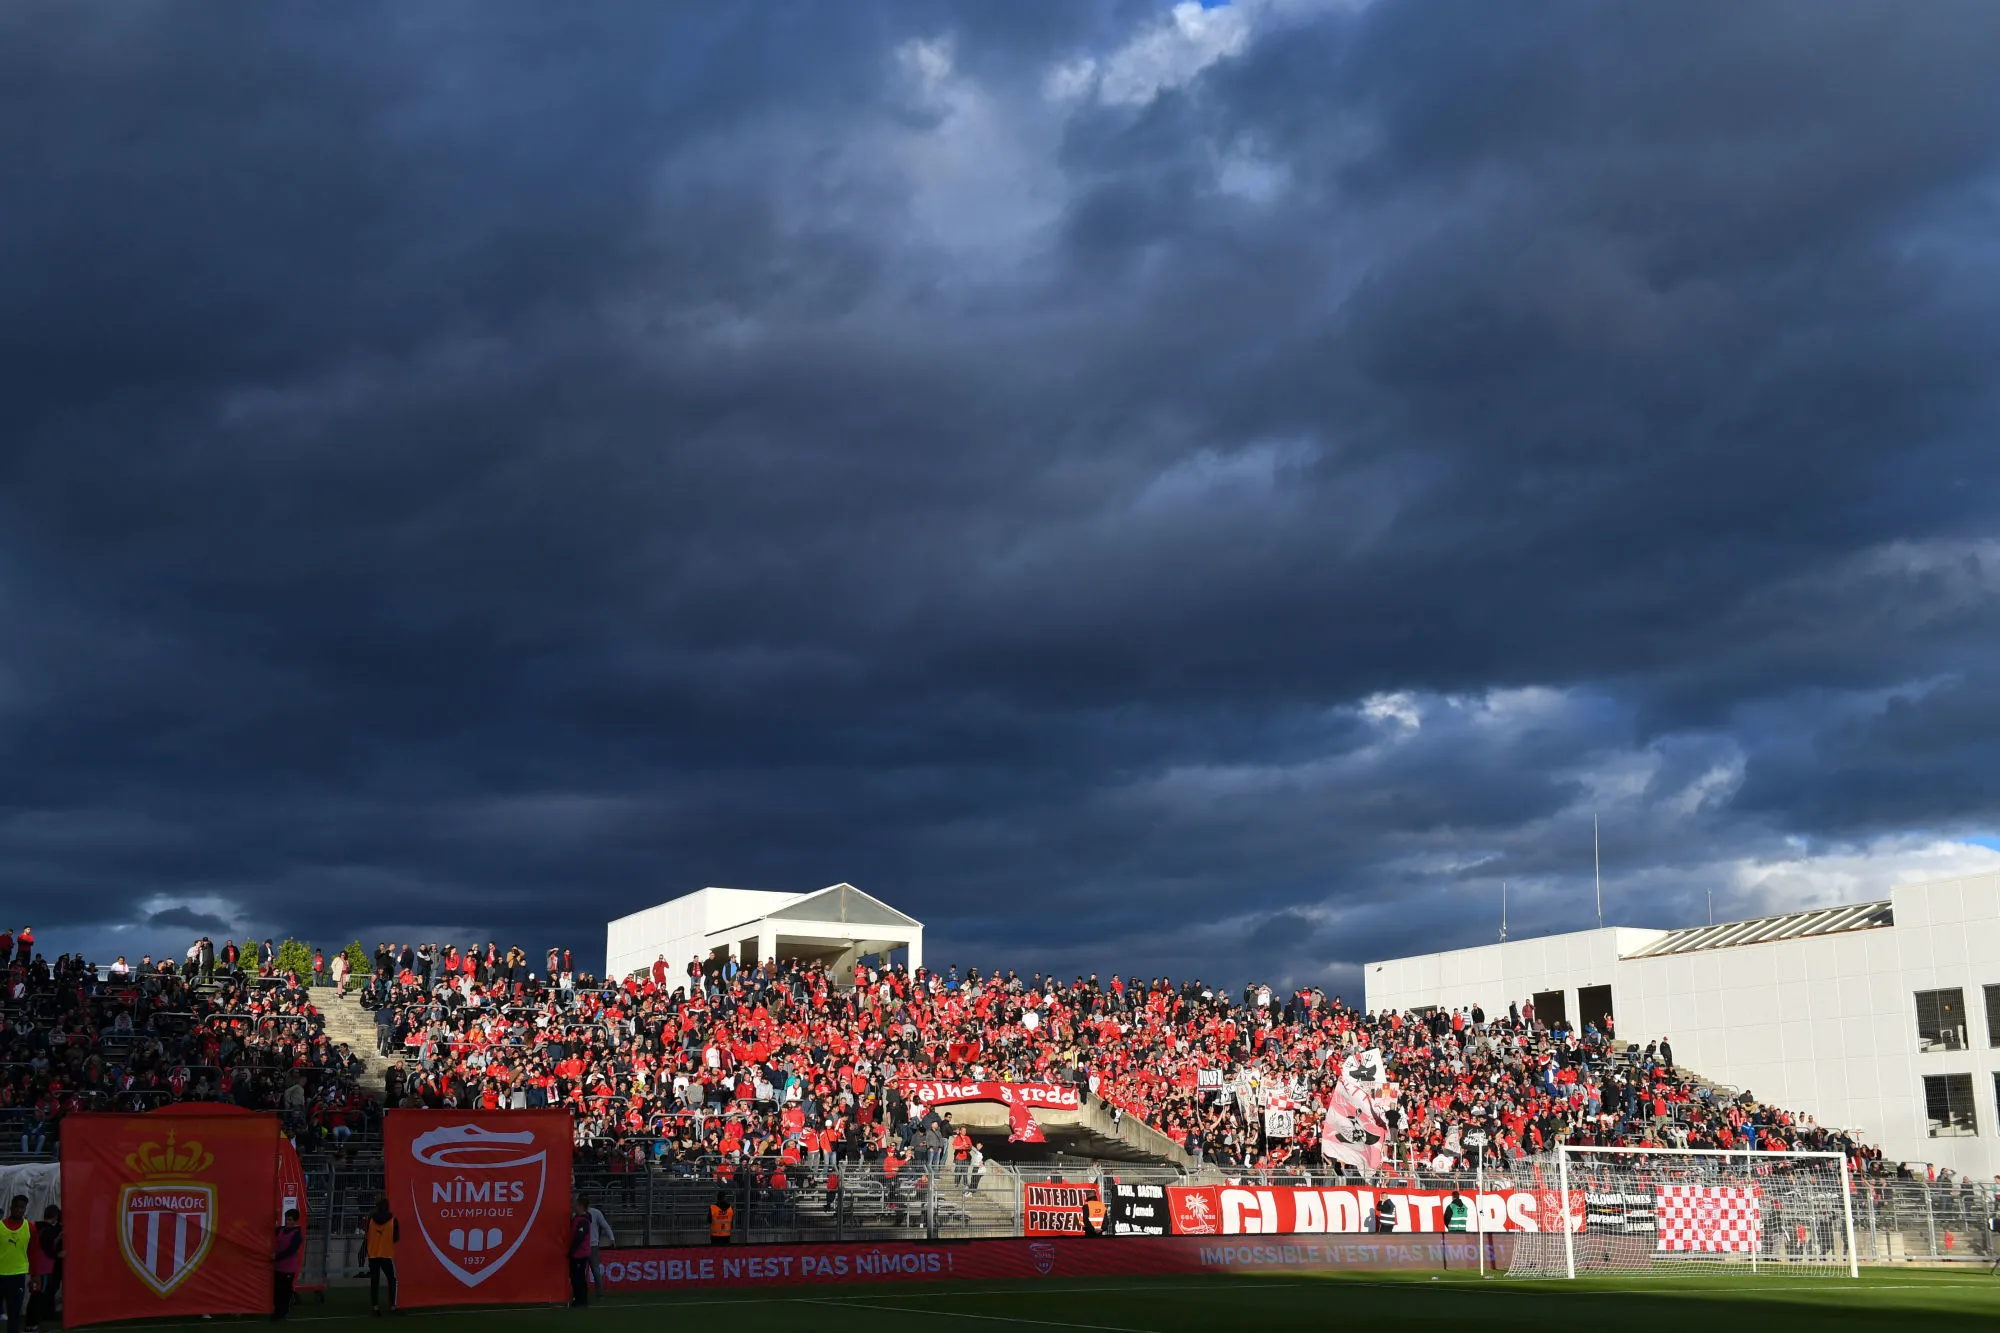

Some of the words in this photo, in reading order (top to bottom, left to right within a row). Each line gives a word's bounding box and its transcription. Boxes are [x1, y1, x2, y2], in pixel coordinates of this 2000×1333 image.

[432, 1175, 525, 1203] NÎMES
[440, 1208, 514, 1218] OLYMPIQUE
[1220, 1188, 1538, 1234] GLADIATORS
[464, 1256, 486, 1265] 1937
[801, 1255, 849, 1277] PAS
[855, 1248, 942, 1275] NÎMOIS
[1200, 1245, 1320, 1265] IMPOSSIBLE
[1386, 1244, 1423, 1262] PAS
